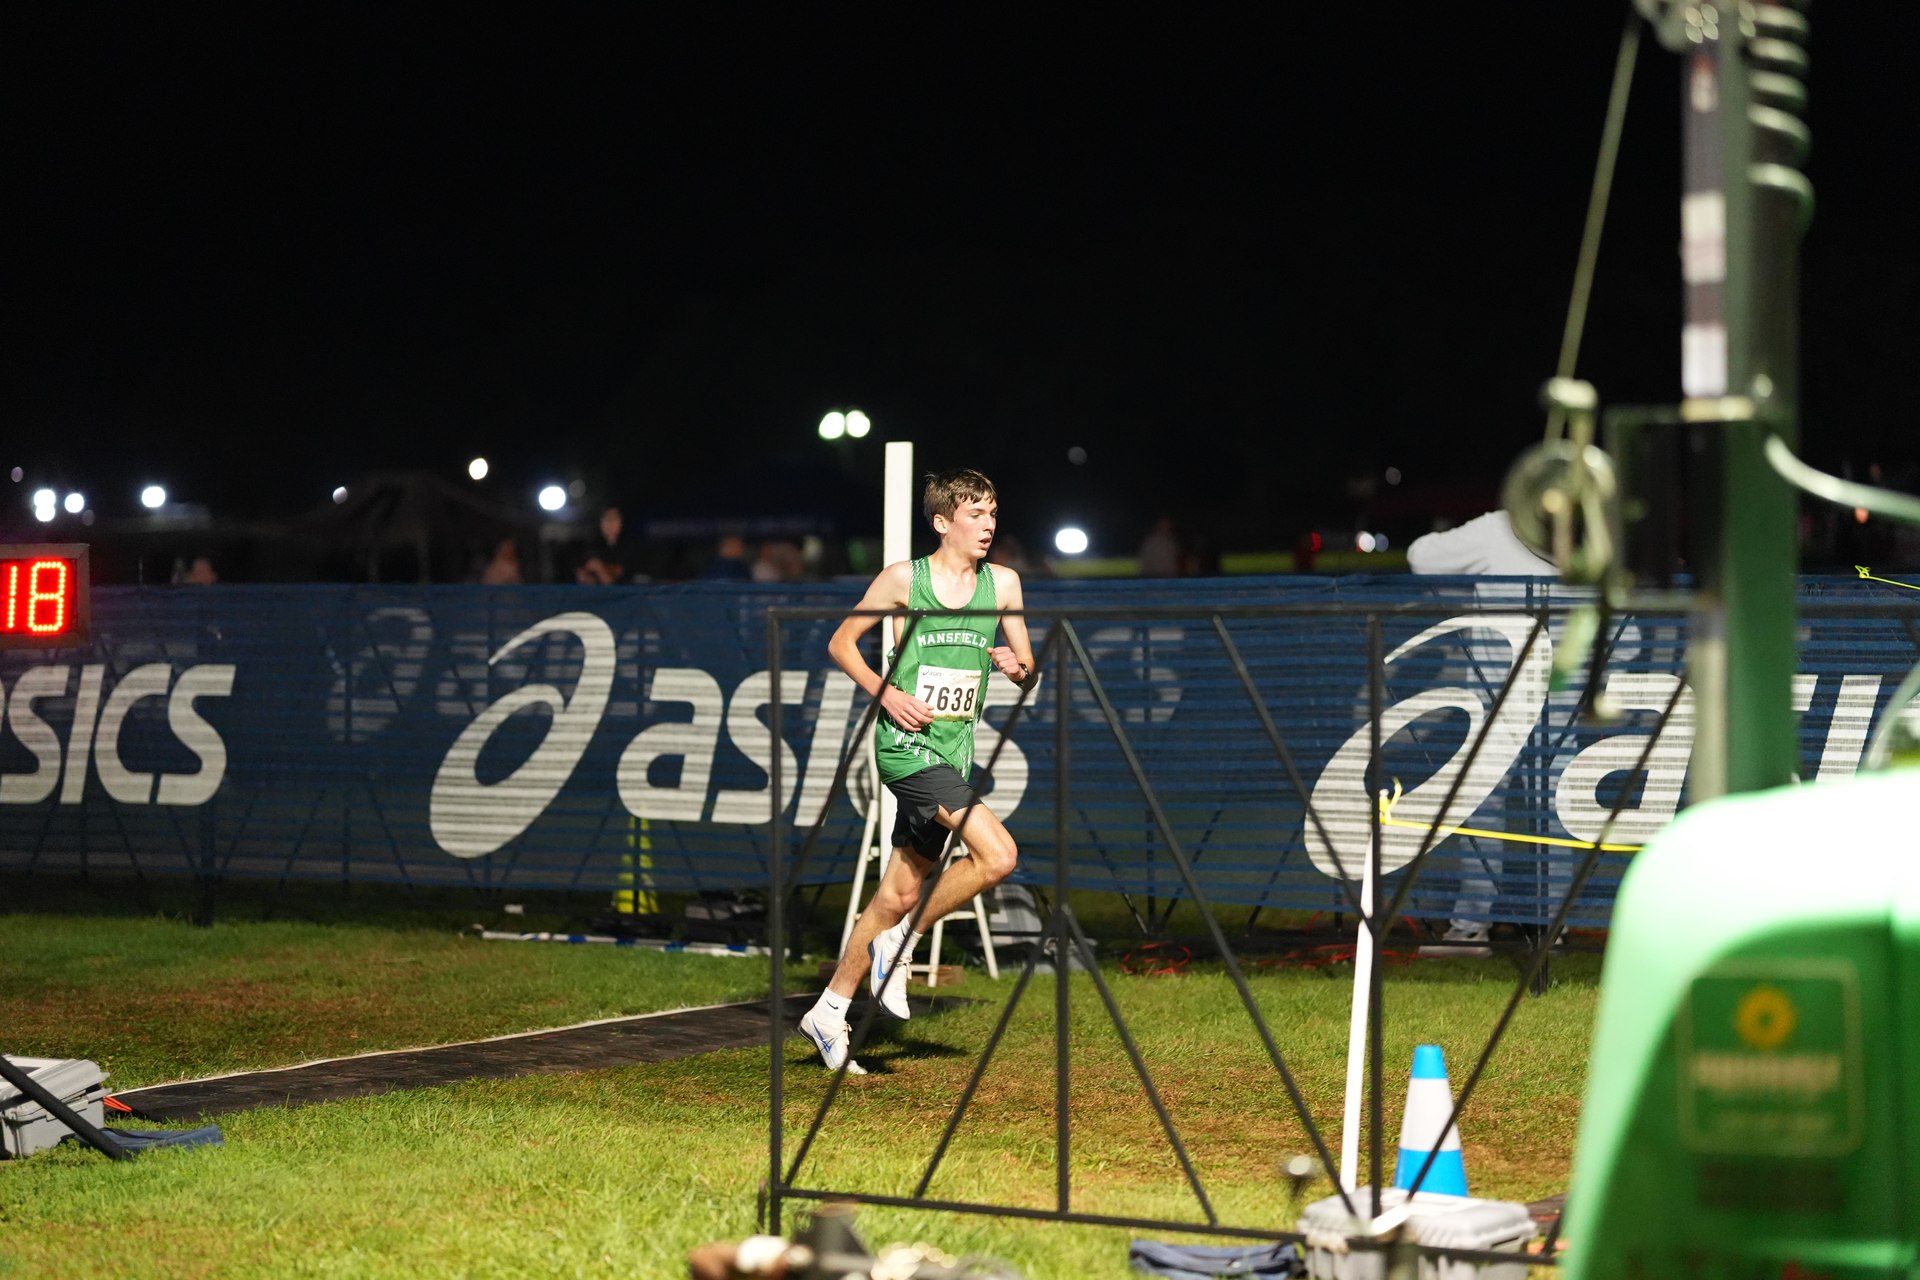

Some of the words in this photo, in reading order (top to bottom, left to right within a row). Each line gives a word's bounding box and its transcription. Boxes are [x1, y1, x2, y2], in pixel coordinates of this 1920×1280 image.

[8, 562, 66, 632] 18
[917, 632, 987, 648] MANSFIELD
[923, 685, 975, 711] 7638
[0, 663, 236, 806] sics
[617, 668, 1042, 826] asis
